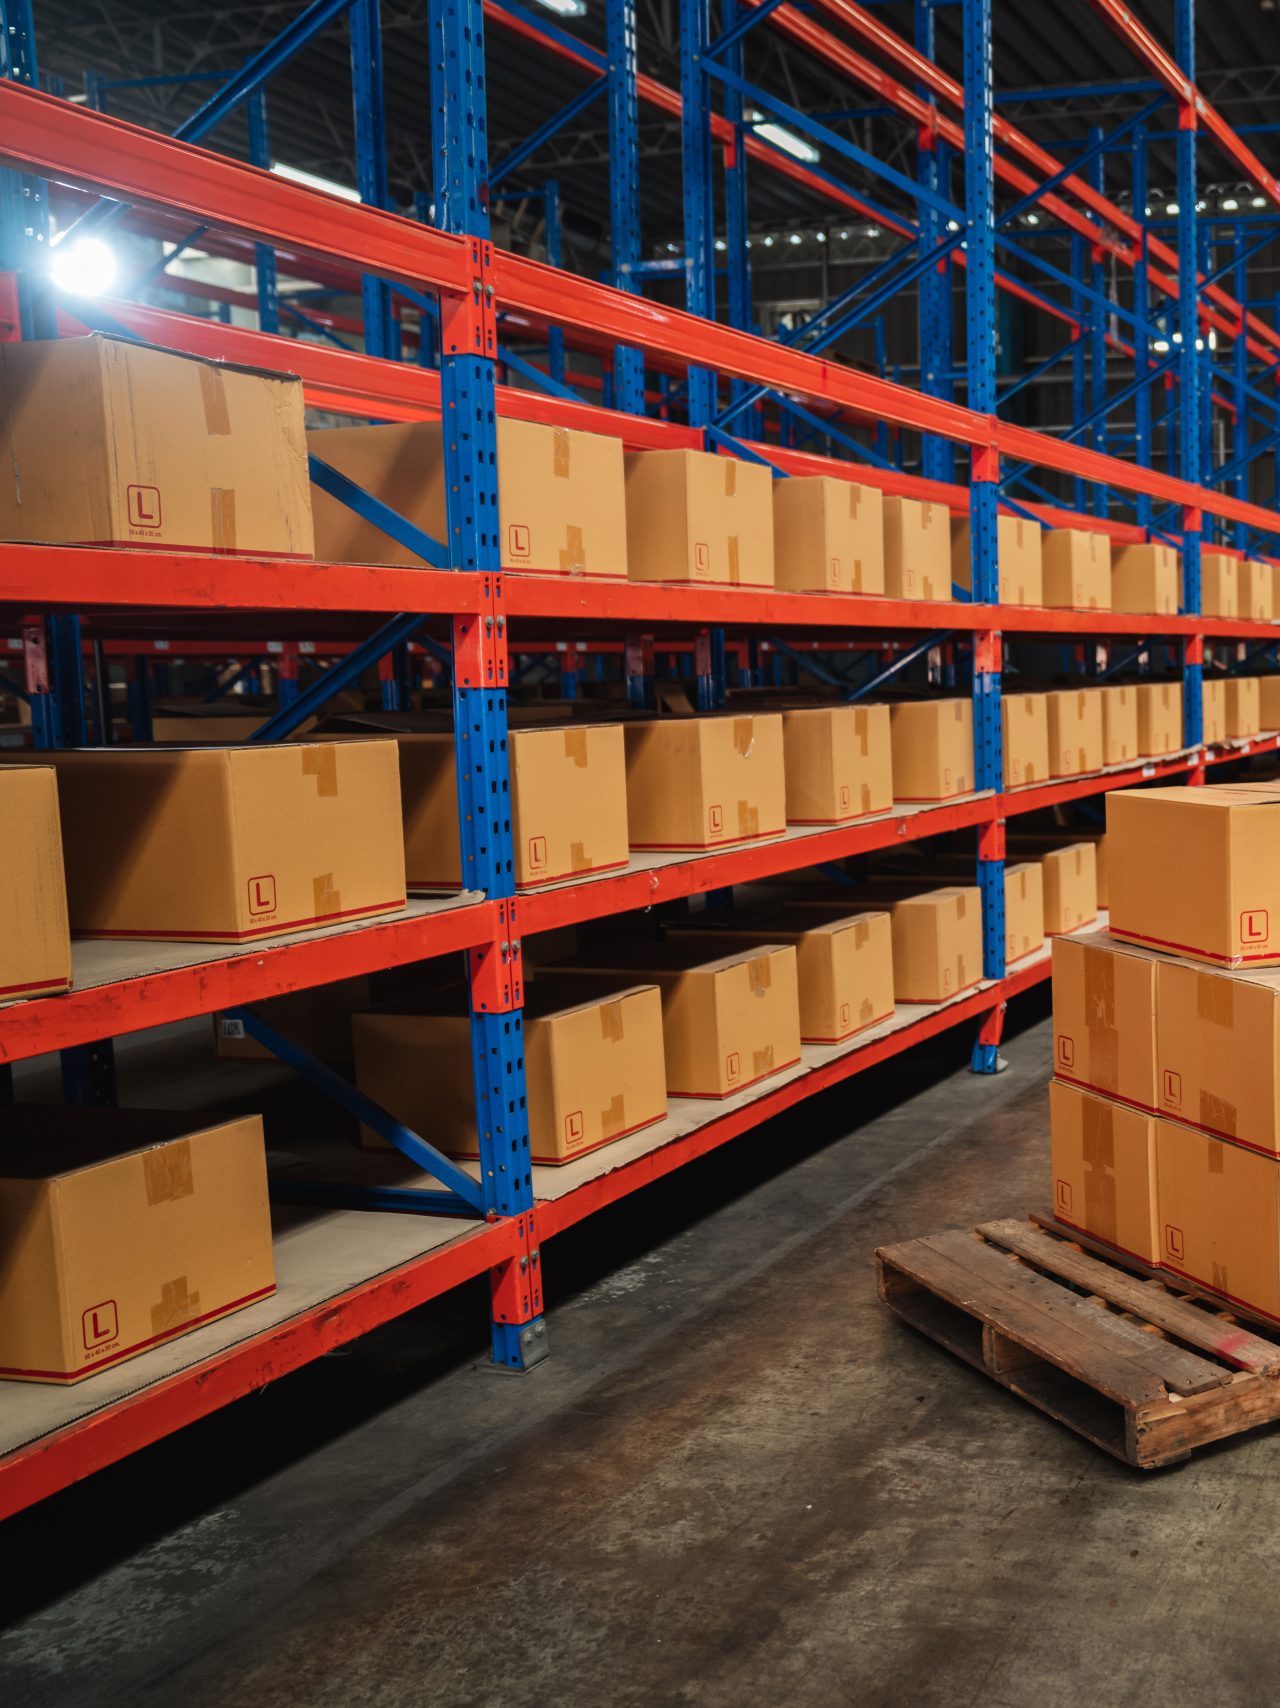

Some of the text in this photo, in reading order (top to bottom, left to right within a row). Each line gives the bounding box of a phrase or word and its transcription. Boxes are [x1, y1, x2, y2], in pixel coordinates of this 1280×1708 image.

[136, 491, 154, 520] L
[515, 529, 526, 551] L
[713, 810, 720, 827] L
[534, 842, 542, 863] L
[256, 882, 270, 907] L
[1248, 915, 1262, 937] L
[1062, 1040, 1071, 1061] L
[1168, 1075, 1177, 1098] L
[570, 1118, 580, 1137] L
[1170, 1230, 1180, 1253] L
[92, 1312, 111, 1339] L
